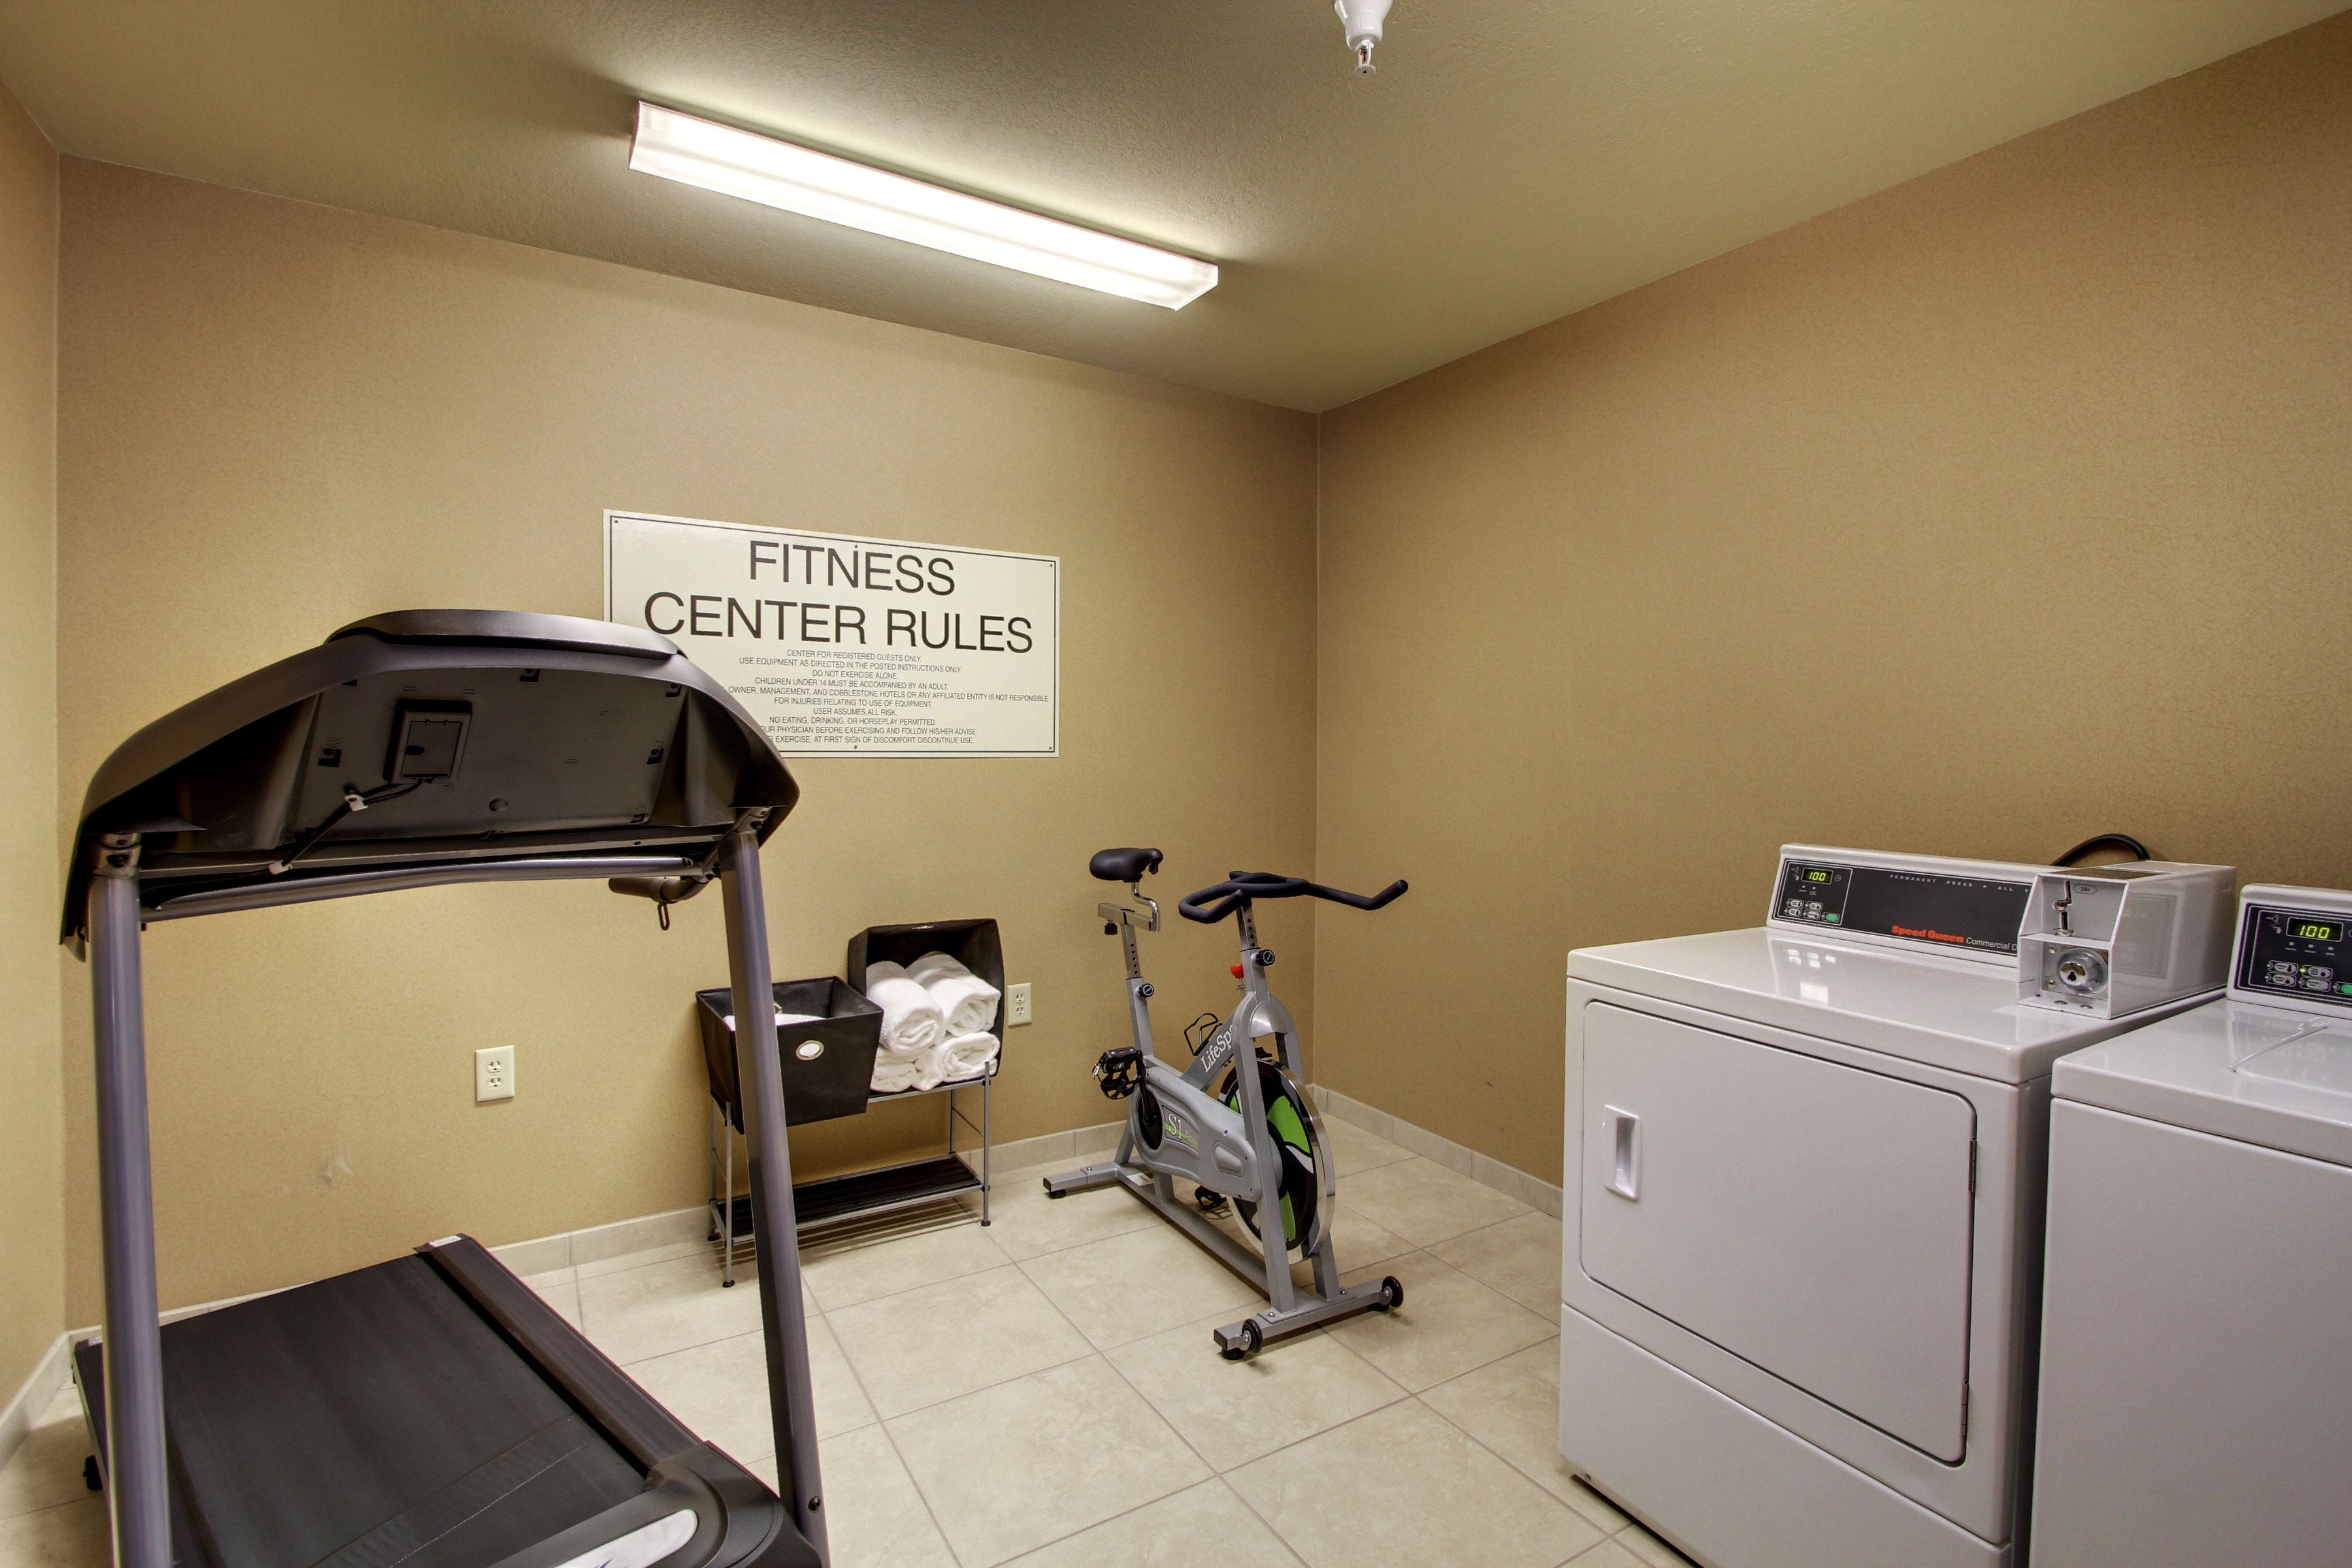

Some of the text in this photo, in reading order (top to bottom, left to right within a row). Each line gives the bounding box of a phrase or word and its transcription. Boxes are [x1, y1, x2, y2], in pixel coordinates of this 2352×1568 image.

[750, 540, 955, 596] FITNESS
[644, 591, 1032, 653] CENTER RULES
[787, 649, 815, 657] CENTER
[833, 652, 875, 660] REGISTERED
[877, 653, 902, 662] GUESTS
[756, 657, 798, 666] EQUIPMENT
[811, 660, 845, 668] DIRECTED
[870, 662, 896, 670] POSTED
[898, 664, 943, 672] INSTRUCTIONS
[755, 677, 791, 685] CHILDREN
[829, 689, 878, 698] COBBLESTONE
[1808, 872, 1826, 881] 100
[1889, 875, 1937, 883] PERMANENT
[1891, 925, 1927, 938] Speed
[1927, 930, 1965, 943] Queen
[1965, 937, 2010, 950] Commercial
[2300, 925, 2330, 938] 100
[1169, 1113, 1182, 1139] S1
